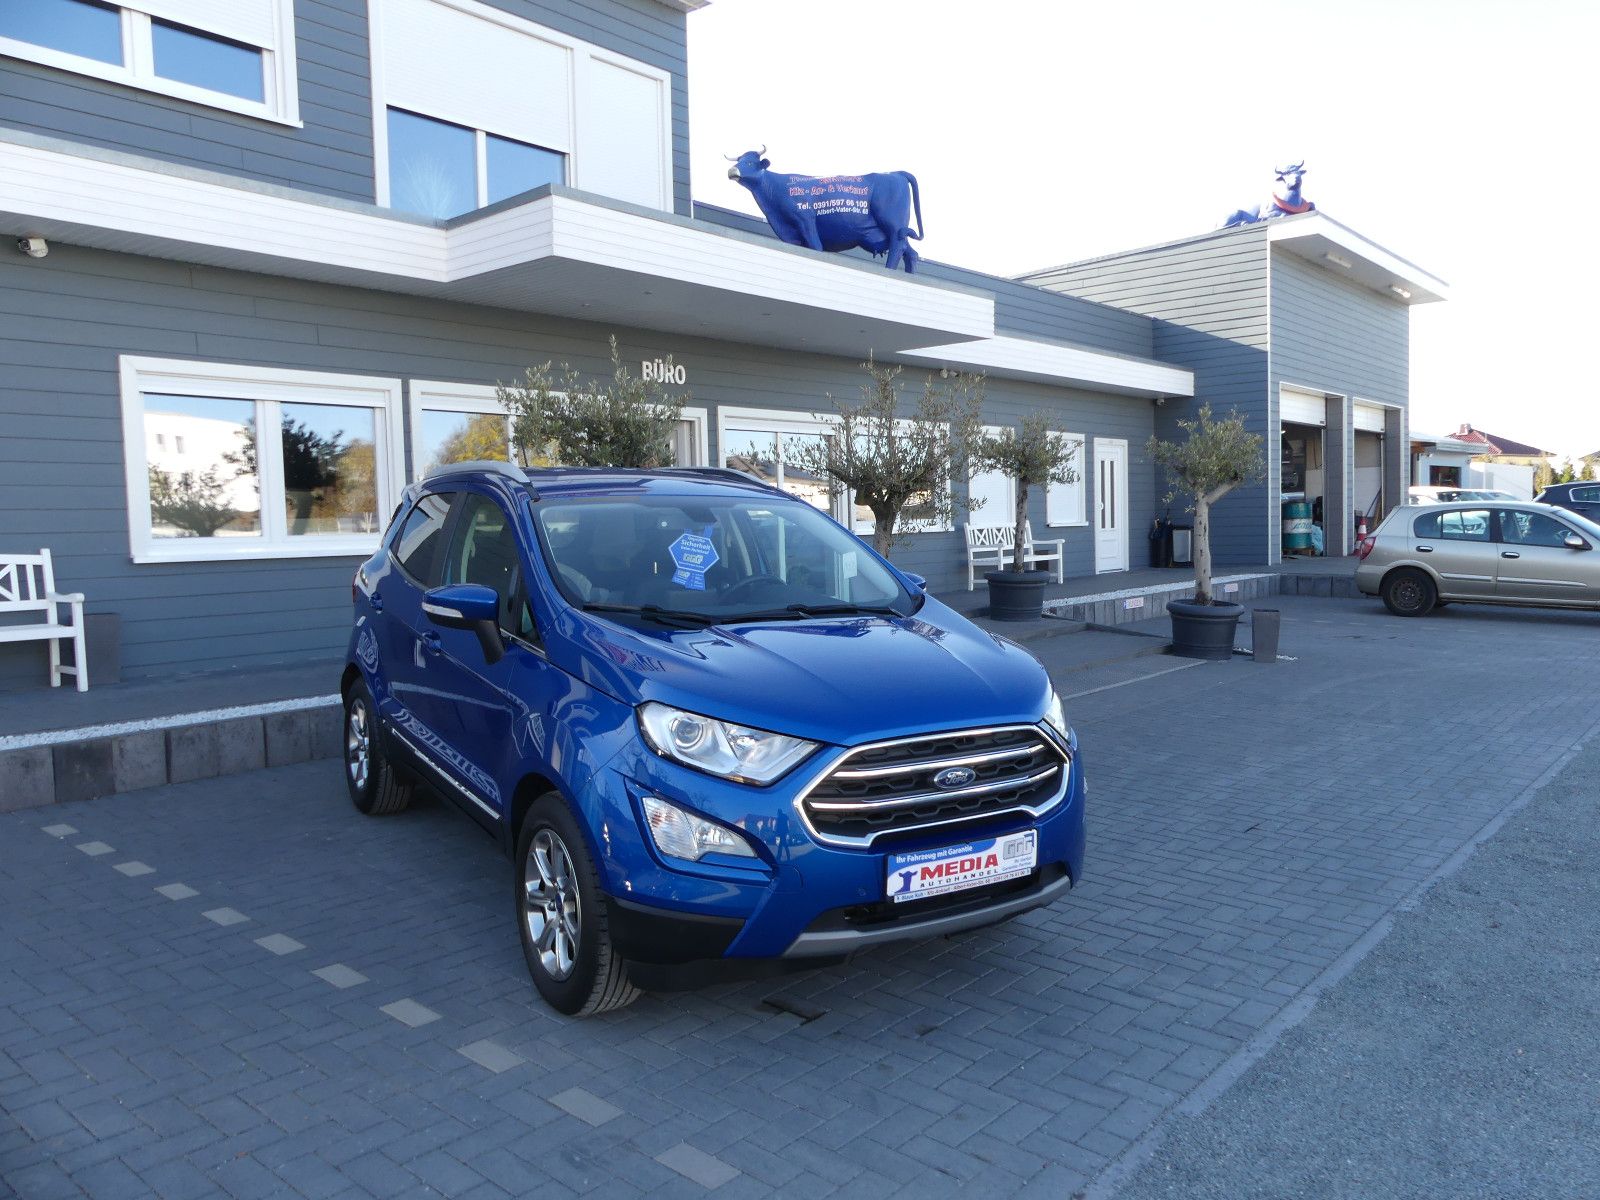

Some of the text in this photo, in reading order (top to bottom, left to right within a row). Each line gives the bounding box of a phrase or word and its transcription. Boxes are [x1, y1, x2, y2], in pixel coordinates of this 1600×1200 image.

[796, 202, 811, 210] Tel.
[813, 199, 845, 210] 0391/597
[855, 200, 868, 209] 100
[641, 358, 687, 385] BÜRO
[680, 539, 711, 551] Sicherheit
[896, 844, 973, 864] Ihr Fahrzeug mit Garantie
[920, 853, 999, 881] MEDIA
[920, 869, 999, 888] AUTOHANDEL
